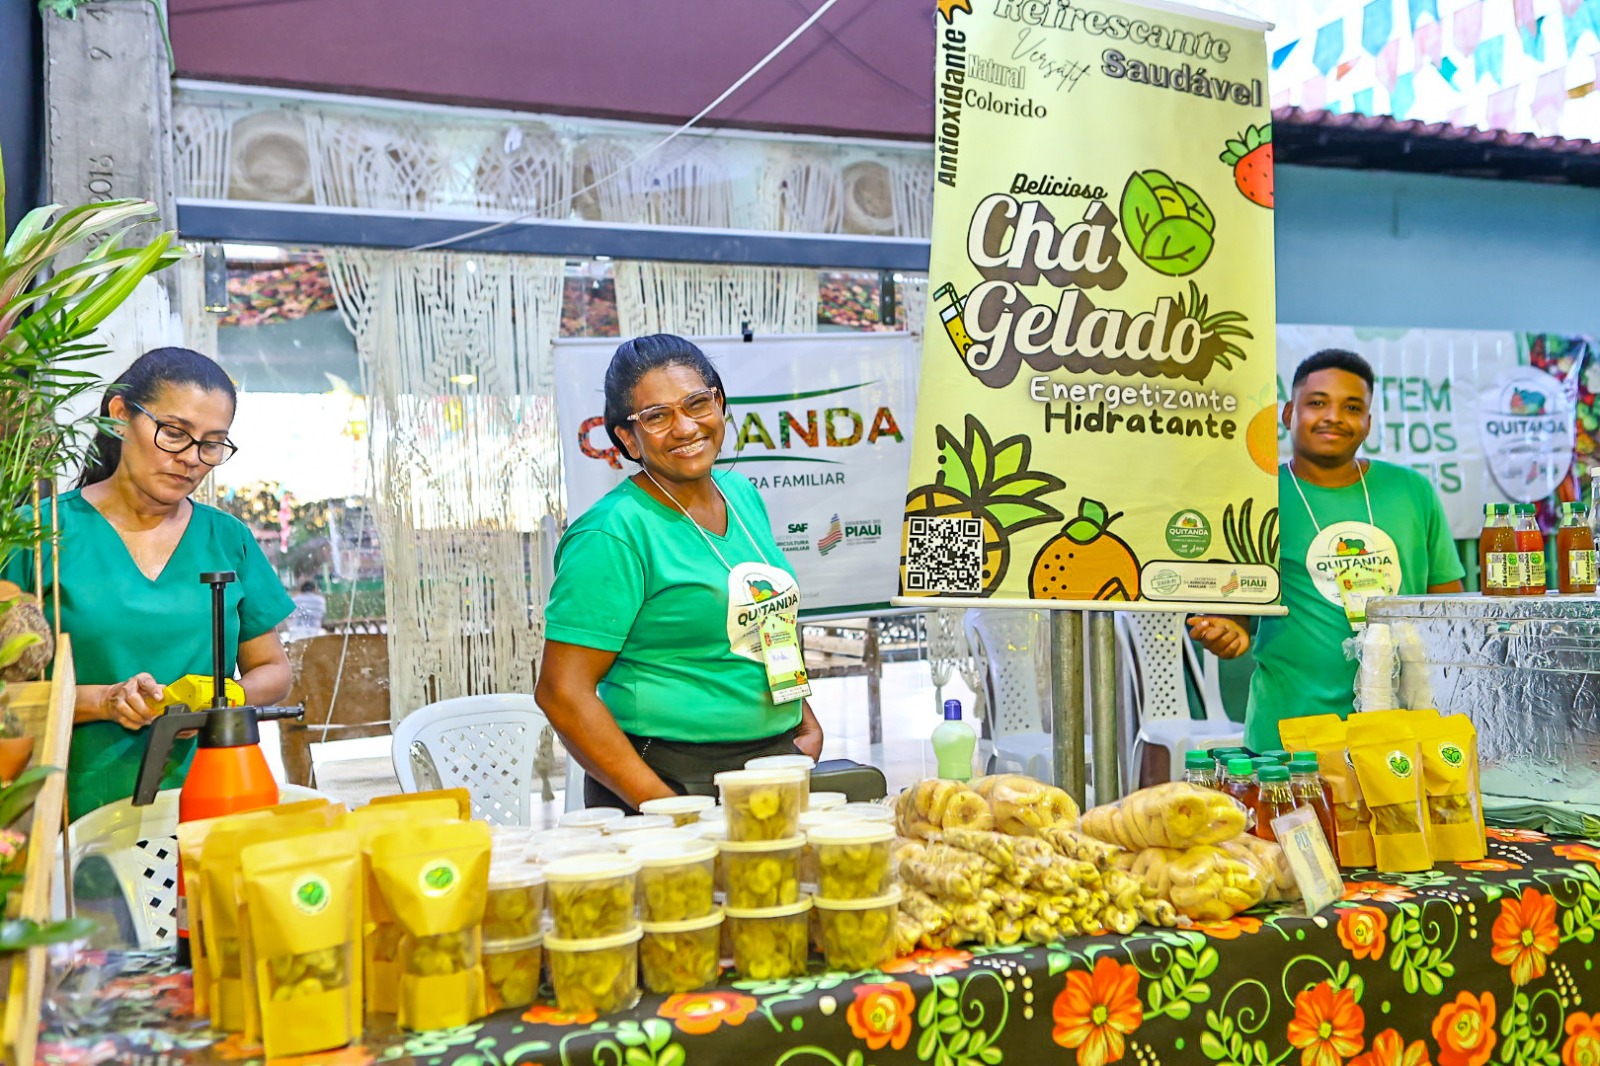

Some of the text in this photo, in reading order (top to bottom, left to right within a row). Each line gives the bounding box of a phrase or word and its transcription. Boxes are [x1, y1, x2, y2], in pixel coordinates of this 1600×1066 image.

[994, 0, 1231, 63] Refrescante
[967, 53, 1026, 89] Natural
[1101, 48, 1263, 107] Saudável
[938, 28, 967, 188] Antioxidante
[964, 88, 1047, 118] Colorido
[1009, 173, 1108, 199] Delicioso
[967, 193, 1115, 275] Chá
[963, 280, 1216, 371] Gelado
[1030, 376, 1238, 412] Energetizante
[1373, 376, 1452, 412] TEM
[578, 406, 905, 470] QANDA
[1045, 401, 1237, 440] Hidratante
[773, 472, 846, 488] FAMILIAR
[787, 523, 809, 534] SAF
[1169, 528, 1209, 537] QUITANDA
